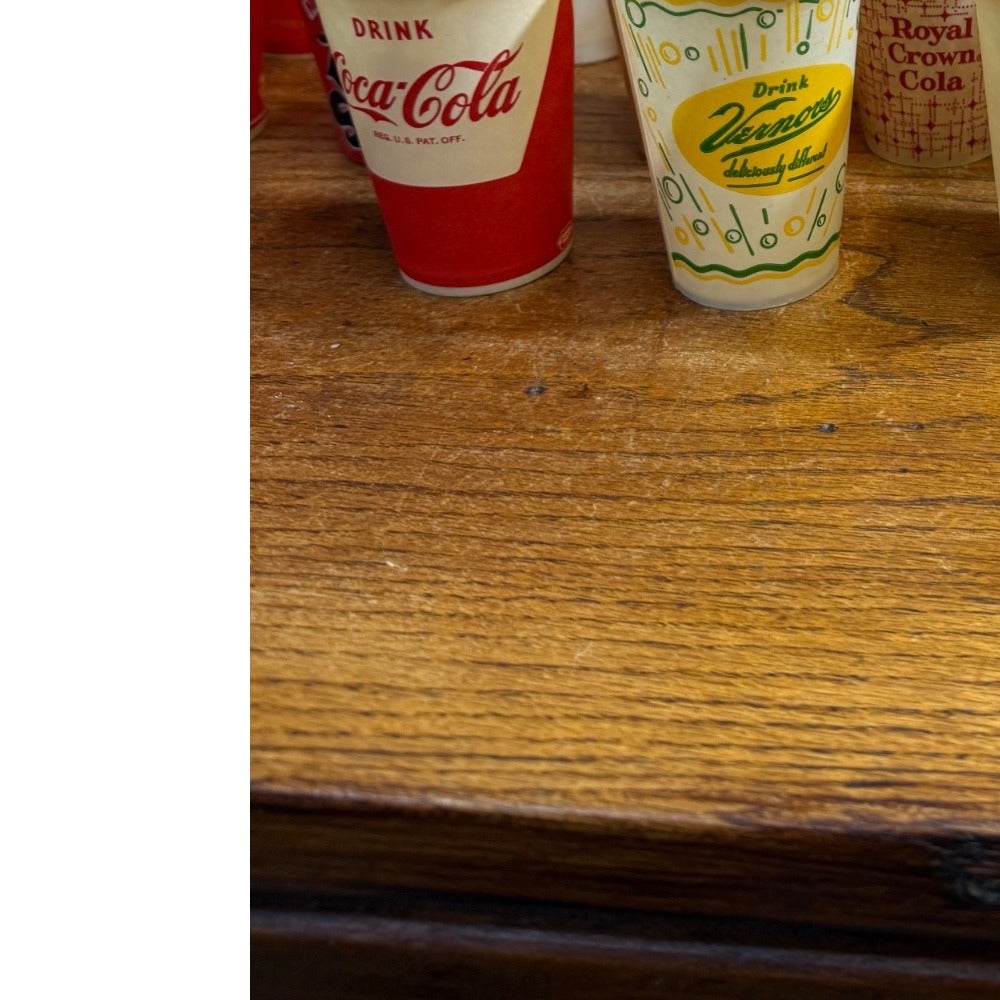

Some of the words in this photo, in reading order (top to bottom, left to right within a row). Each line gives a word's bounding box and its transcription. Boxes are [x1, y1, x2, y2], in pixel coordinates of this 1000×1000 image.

[352, 17, 434, 41] DRINK
[889, 15, 973, 47] Royal
[888, 42, 976, 66] Crown
[752, 74, 809, 98] Drink
[899, 69, 965, 92] Cola
[700, 87, 841, 160] Vernors
[416, 137, 439, 145] PAT.
[441, 134, 466, 144] OFF.
[723, 154, 786, 184] deliciously
